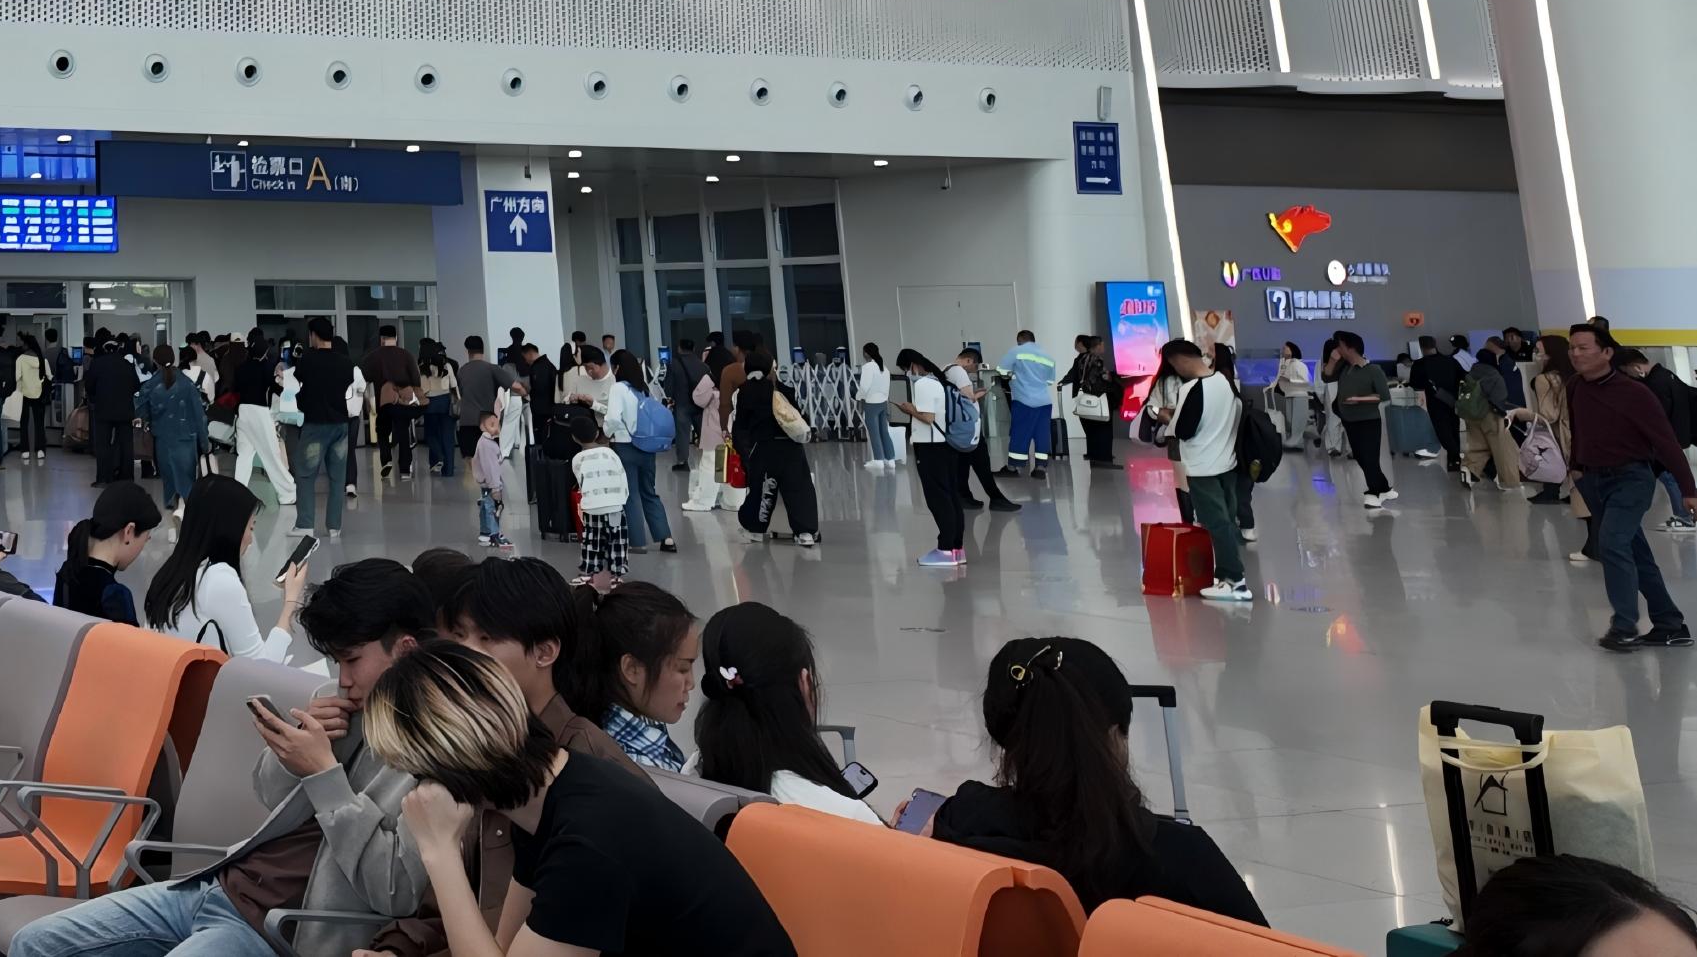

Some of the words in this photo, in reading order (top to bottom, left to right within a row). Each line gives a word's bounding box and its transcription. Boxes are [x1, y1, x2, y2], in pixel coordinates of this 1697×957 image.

[251, 155, 303, 176] 检票口
[306, 156, 332, 191] A
[490, 196, 546, 214] 广州方向
